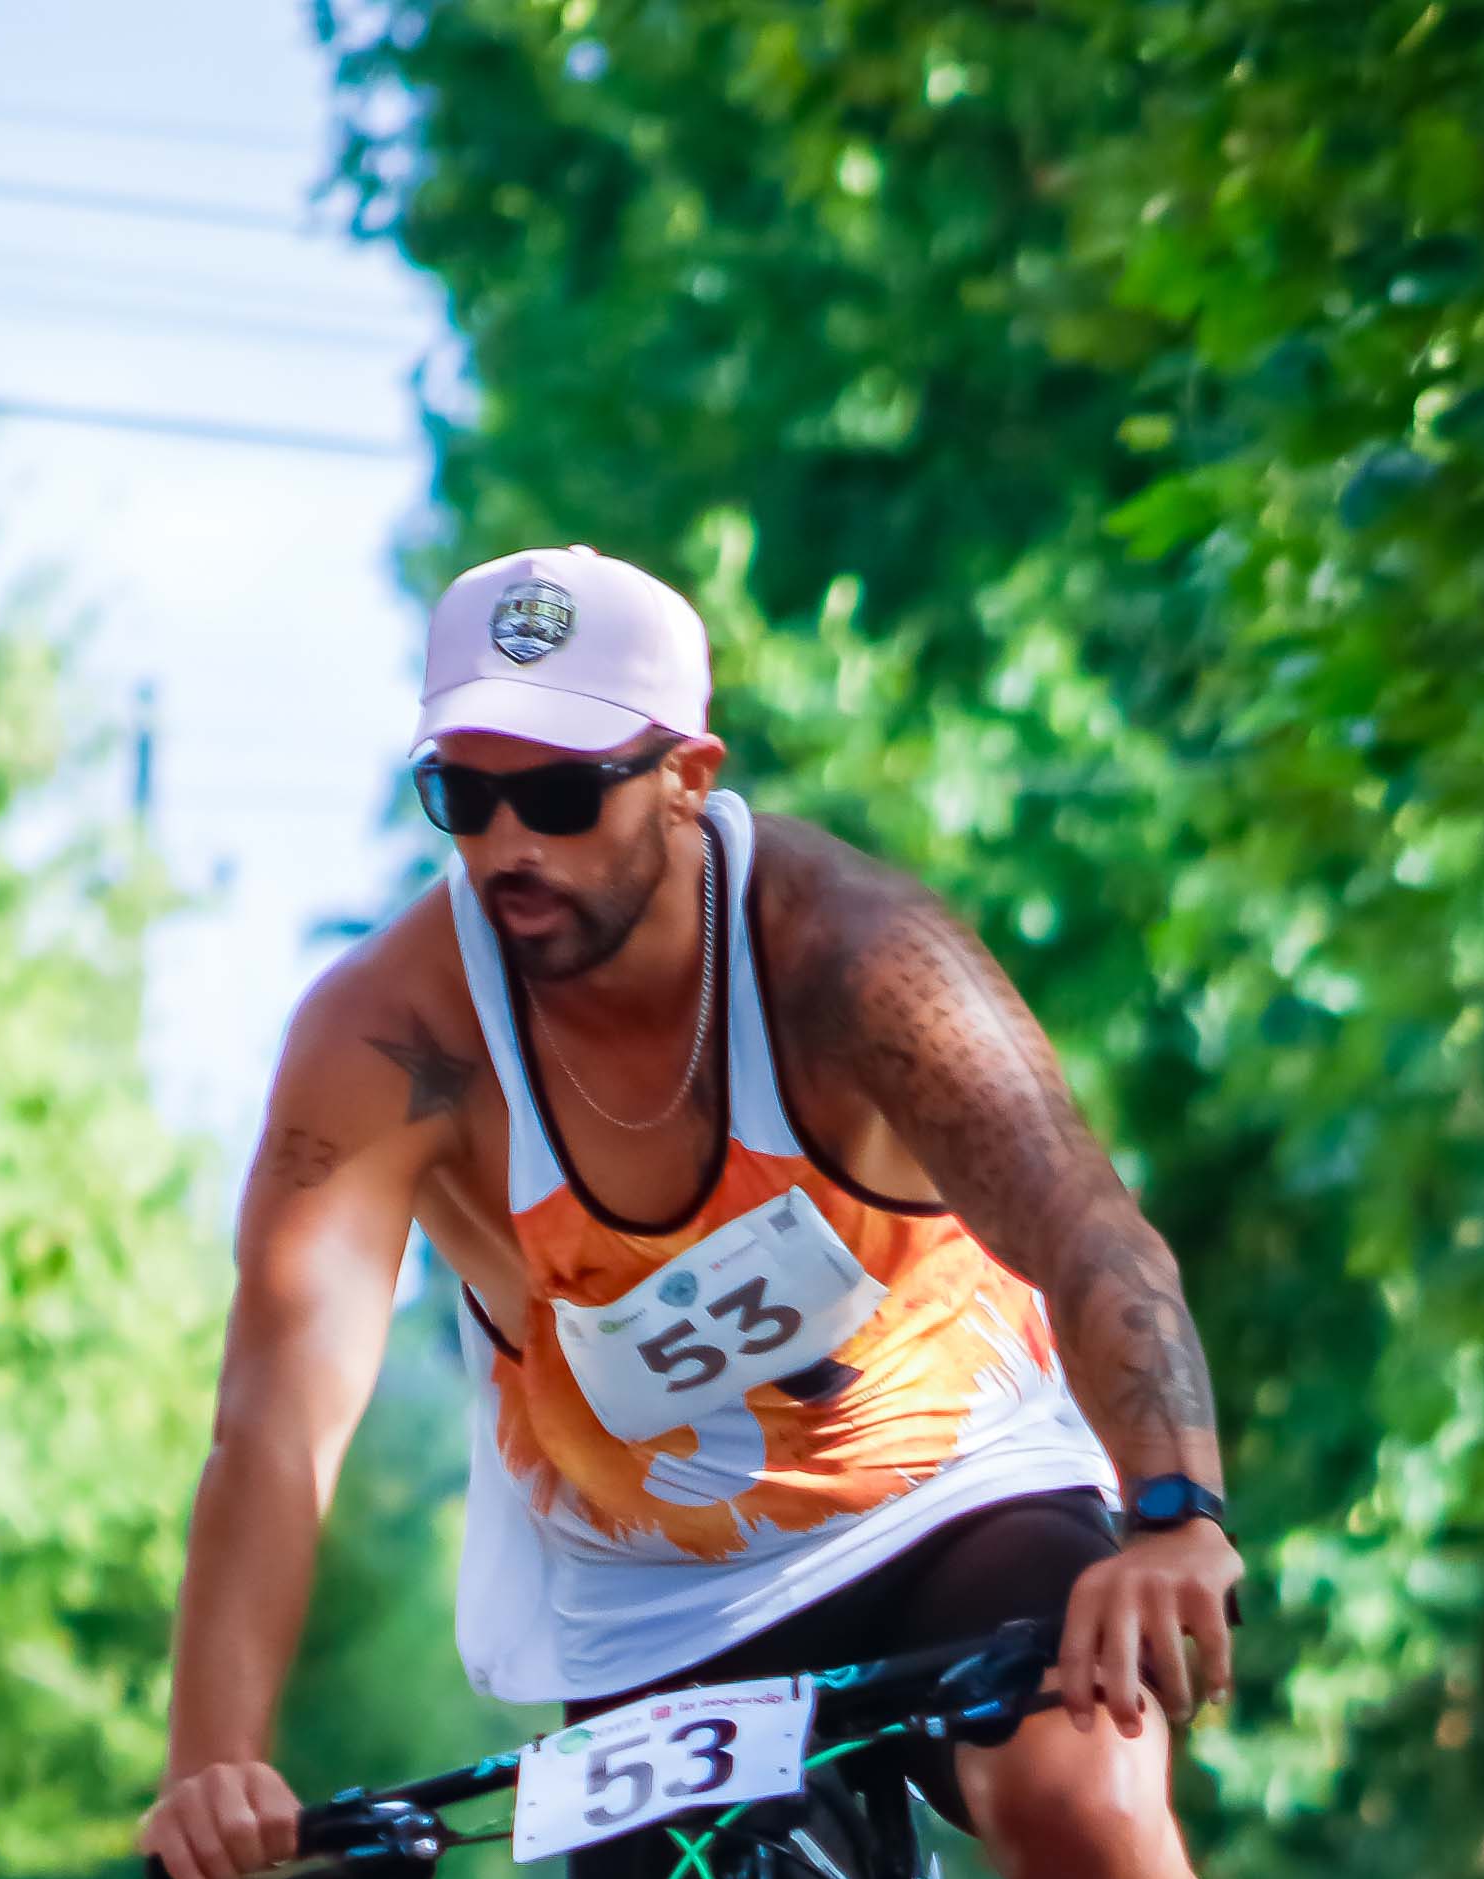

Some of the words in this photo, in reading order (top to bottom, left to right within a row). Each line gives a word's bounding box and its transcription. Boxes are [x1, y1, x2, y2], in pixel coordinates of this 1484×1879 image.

[274, 1127, 338, 1189] 53
[637, 1276, 802, 1393] 53
[584, 1719, 738, 1827] 53
